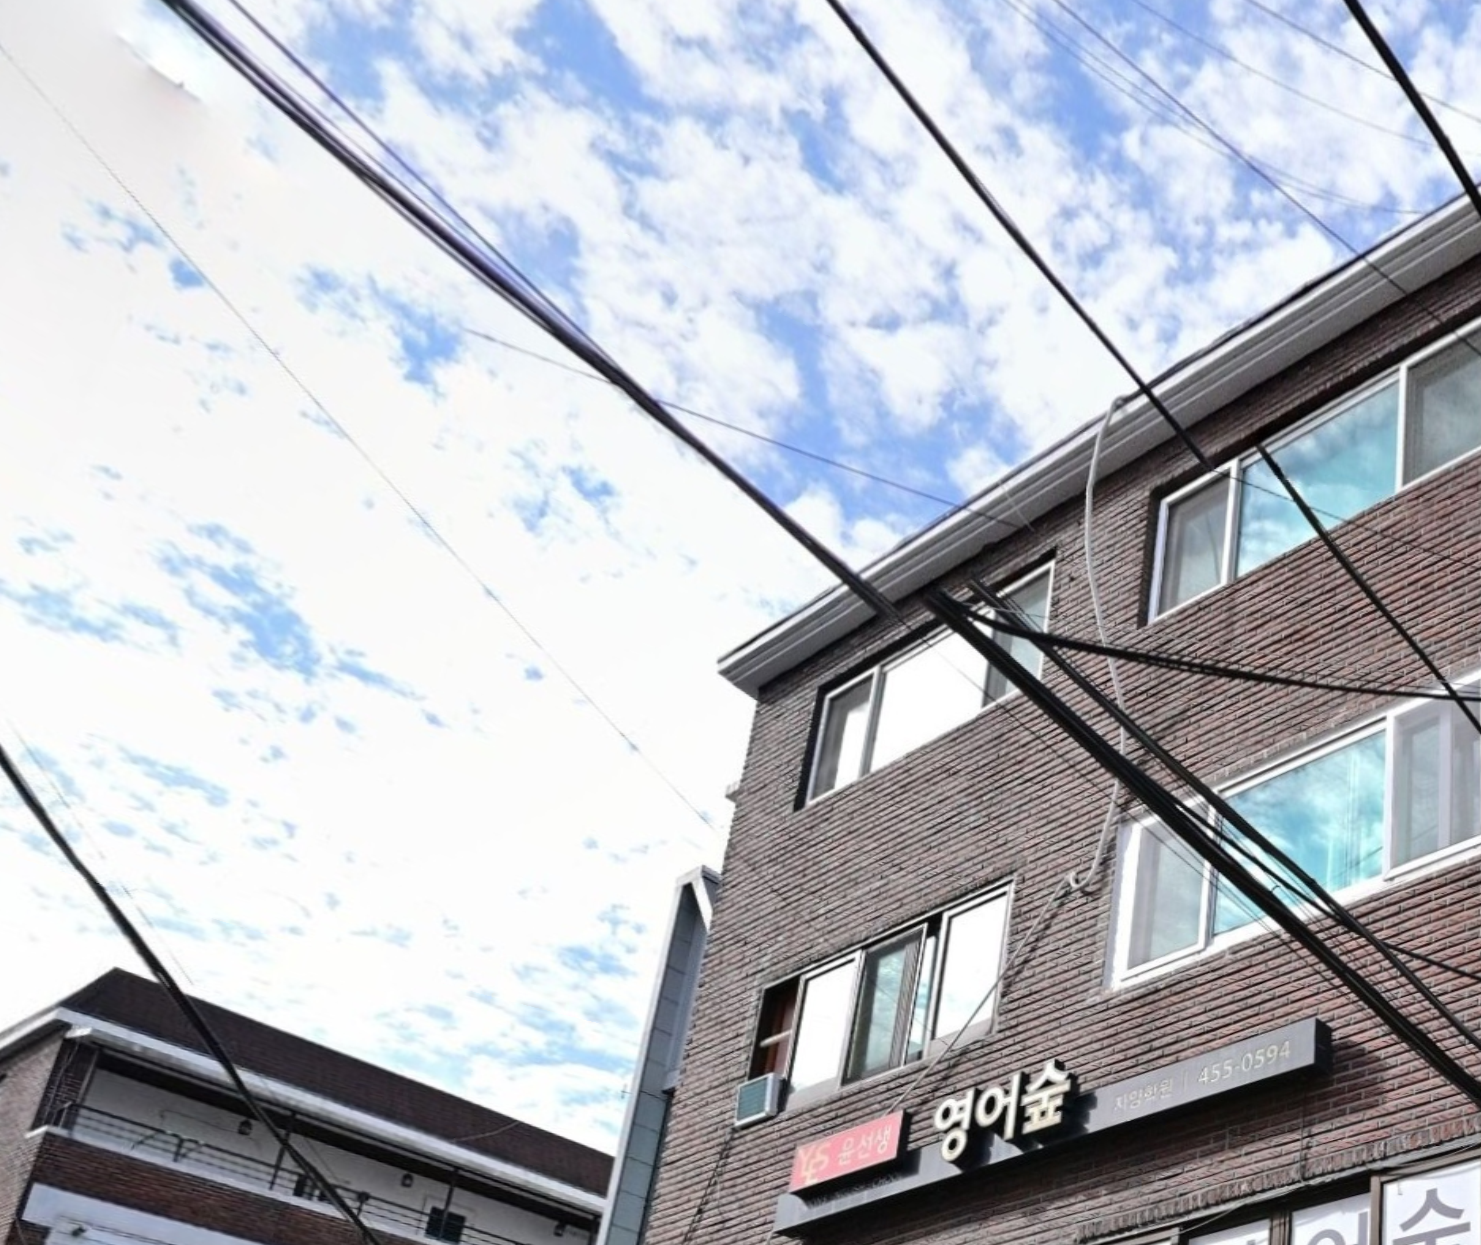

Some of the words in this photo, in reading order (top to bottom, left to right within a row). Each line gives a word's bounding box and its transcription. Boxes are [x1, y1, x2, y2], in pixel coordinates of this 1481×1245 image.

[1113, 1076, 1174, 1112] 자양학원
[1197, 1040, 1292, 1087] 455-0594
[932, 1058, 1074, 1163] 영어숲
[797, 1139, 833, 1185] YES
[837, 1126, 893, 1168] 윤선생
